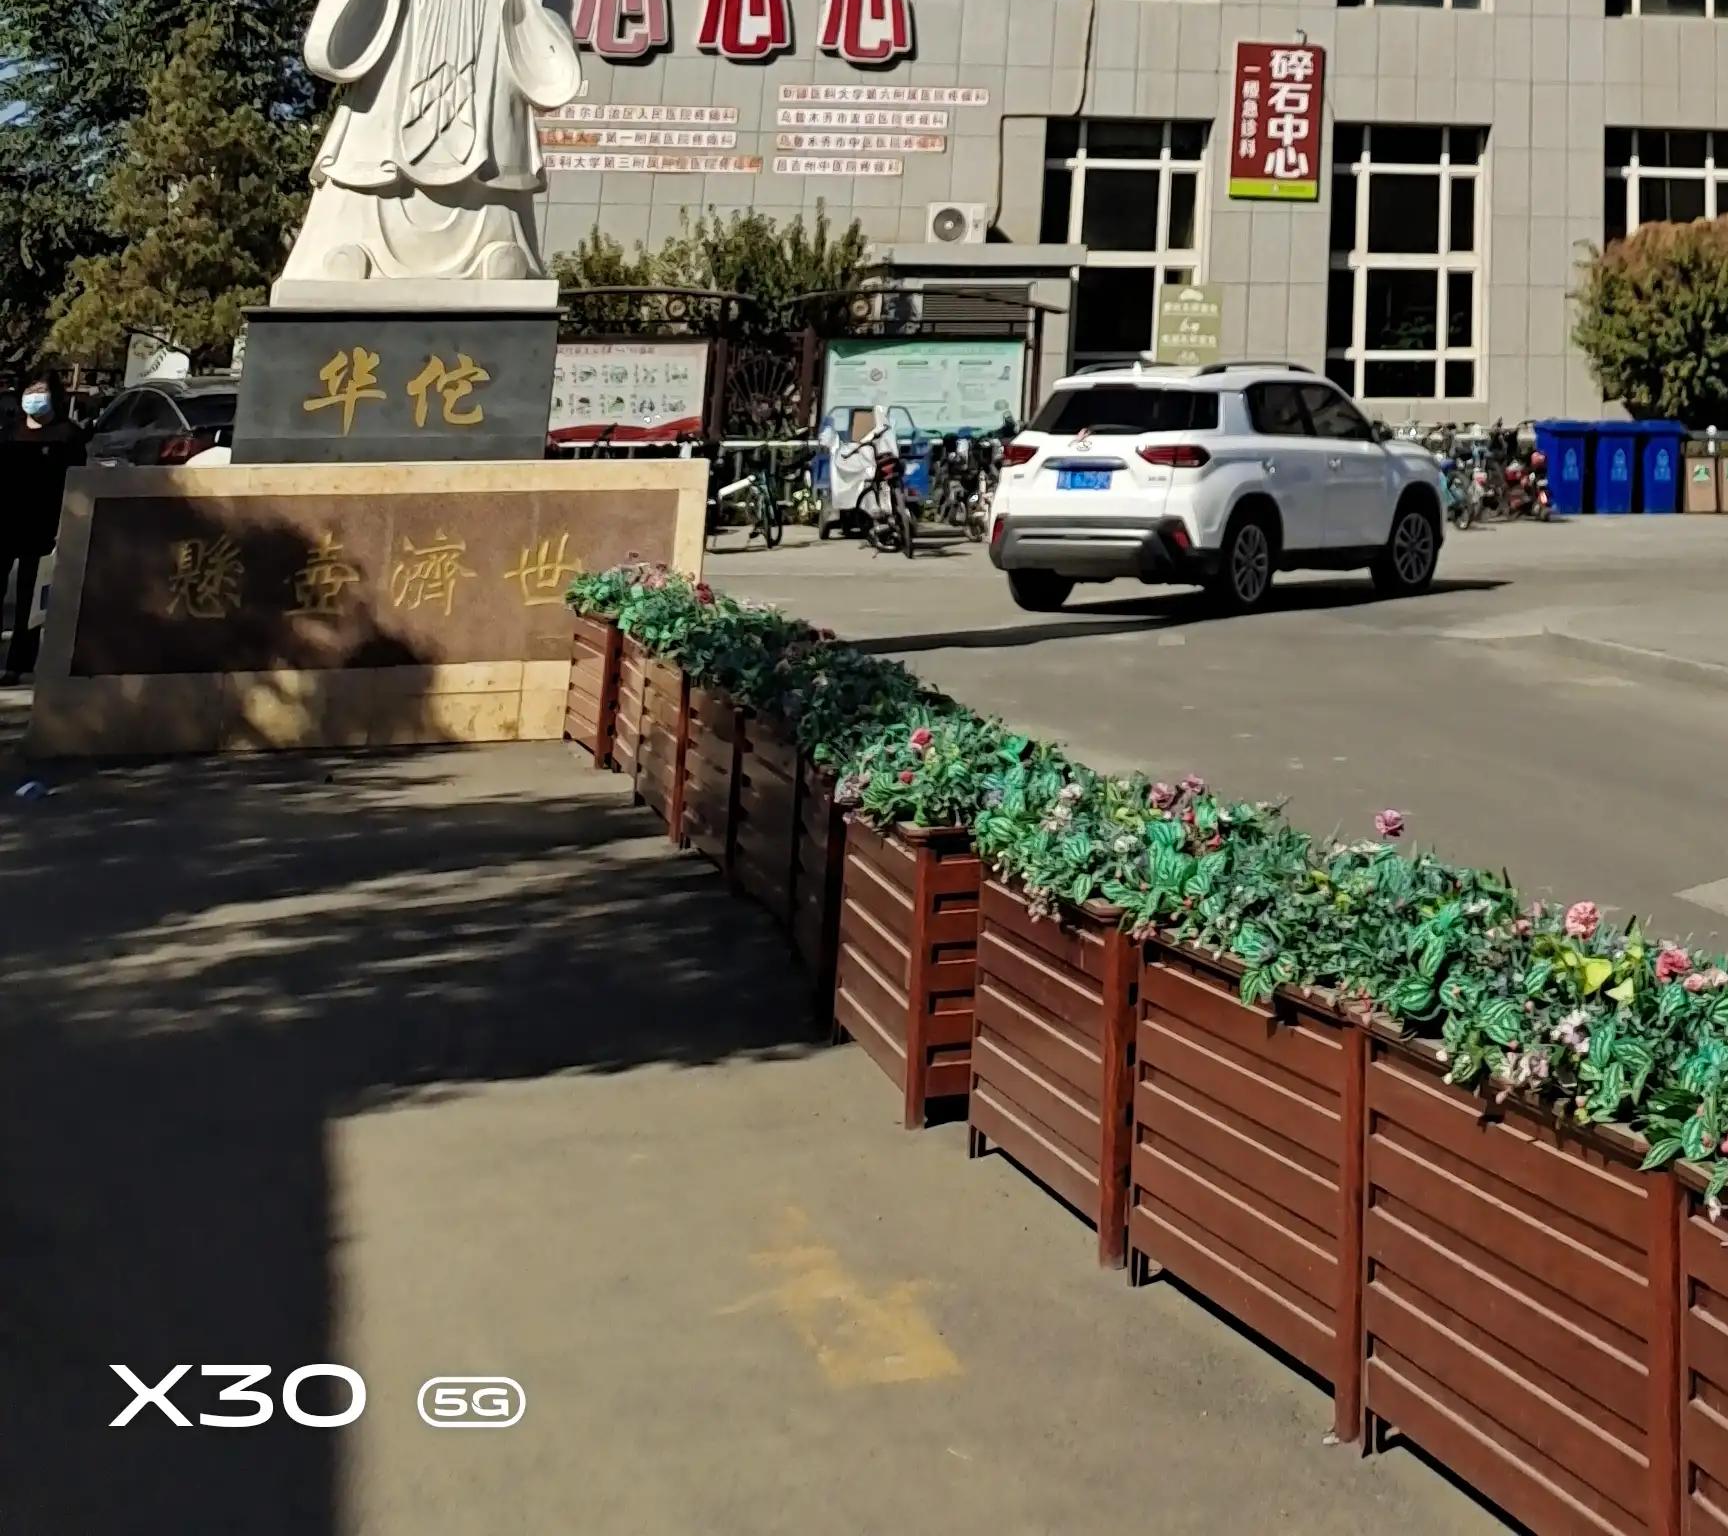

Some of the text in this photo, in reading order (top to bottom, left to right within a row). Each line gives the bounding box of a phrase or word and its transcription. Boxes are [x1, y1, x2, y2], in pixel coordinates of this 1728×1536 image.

[1264, 49, 1314, 178] 碎石中心
[304, 347, 490, 436] 华佗
